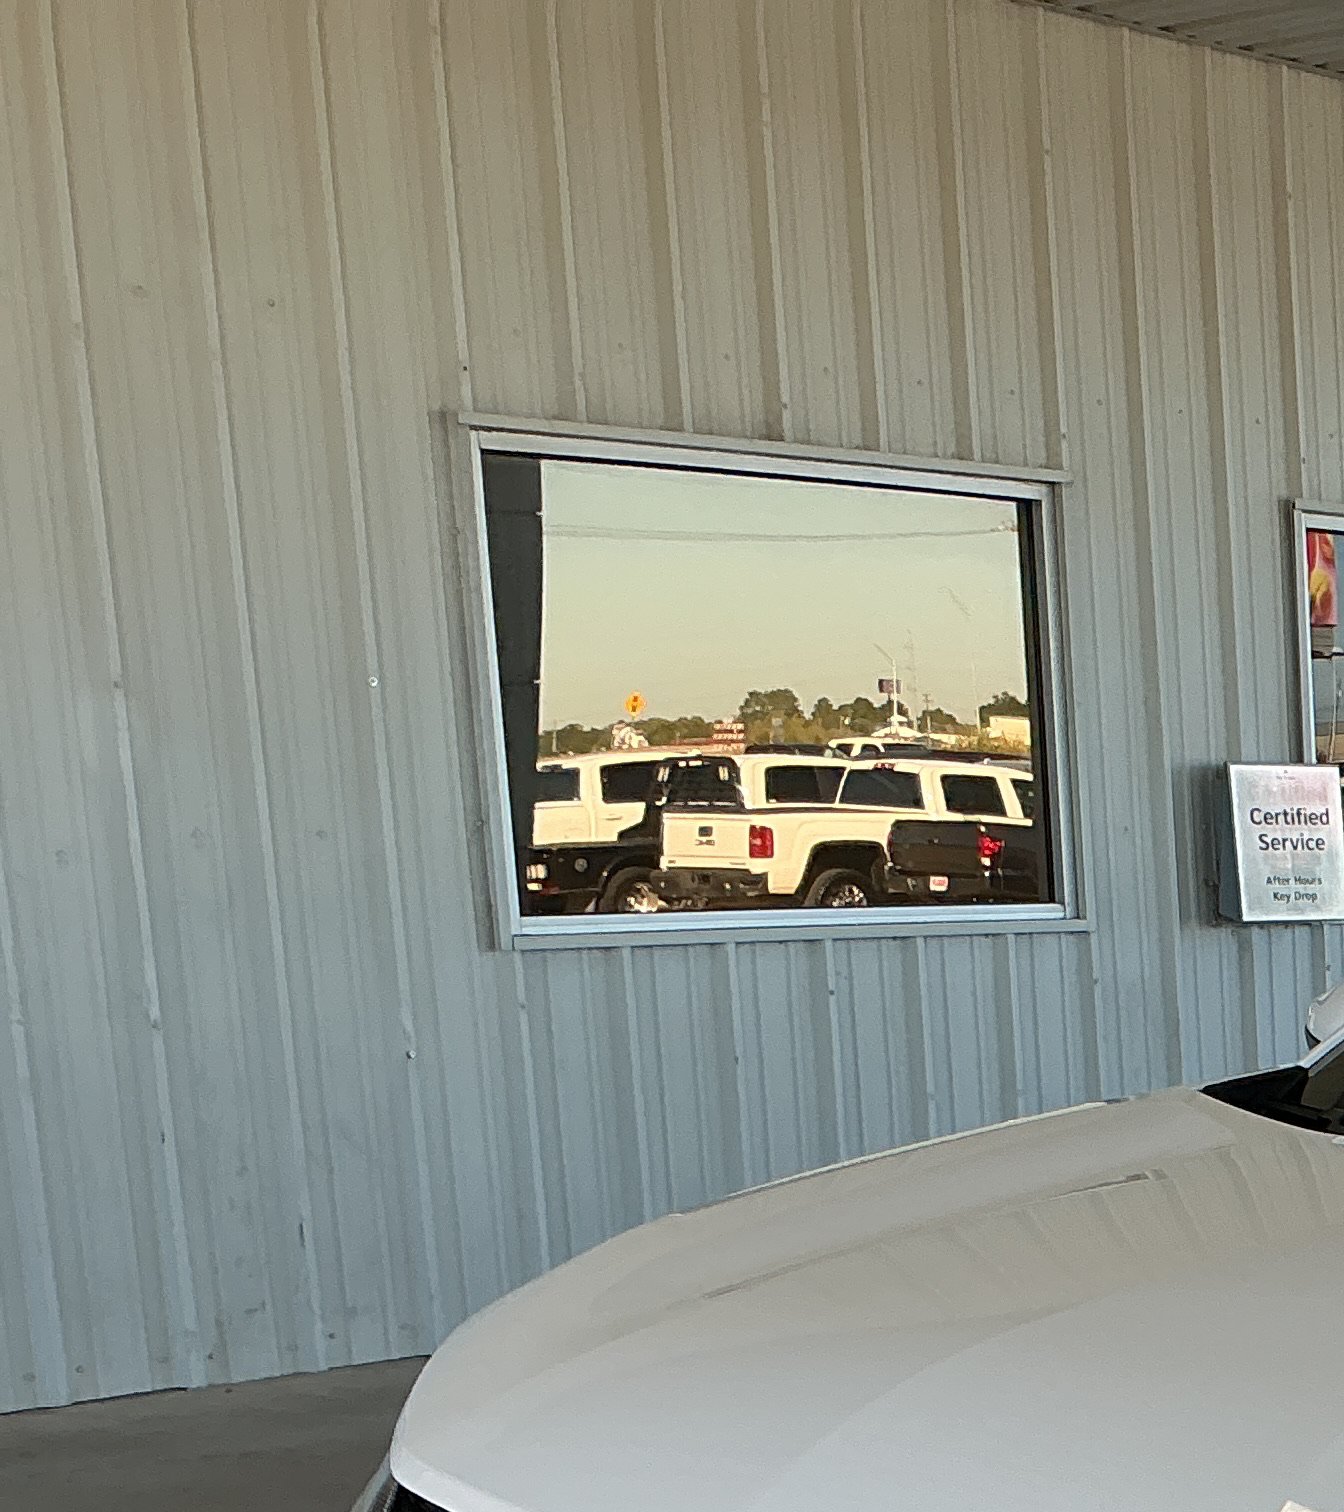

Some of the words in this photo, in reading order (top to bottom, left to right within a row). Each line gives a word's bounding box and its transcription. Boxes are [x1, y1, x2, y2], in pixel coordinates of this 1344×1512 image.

[1249, 806, 1330, 827] Certified
[1257, 832, 1327, 852] Service
[1265, 875, 1291, 886] After
[1293, 875, 1323, 886] Hours
[1272, 891, 1292, 904] Key
[1293, 891, 1319, 904] Drop
